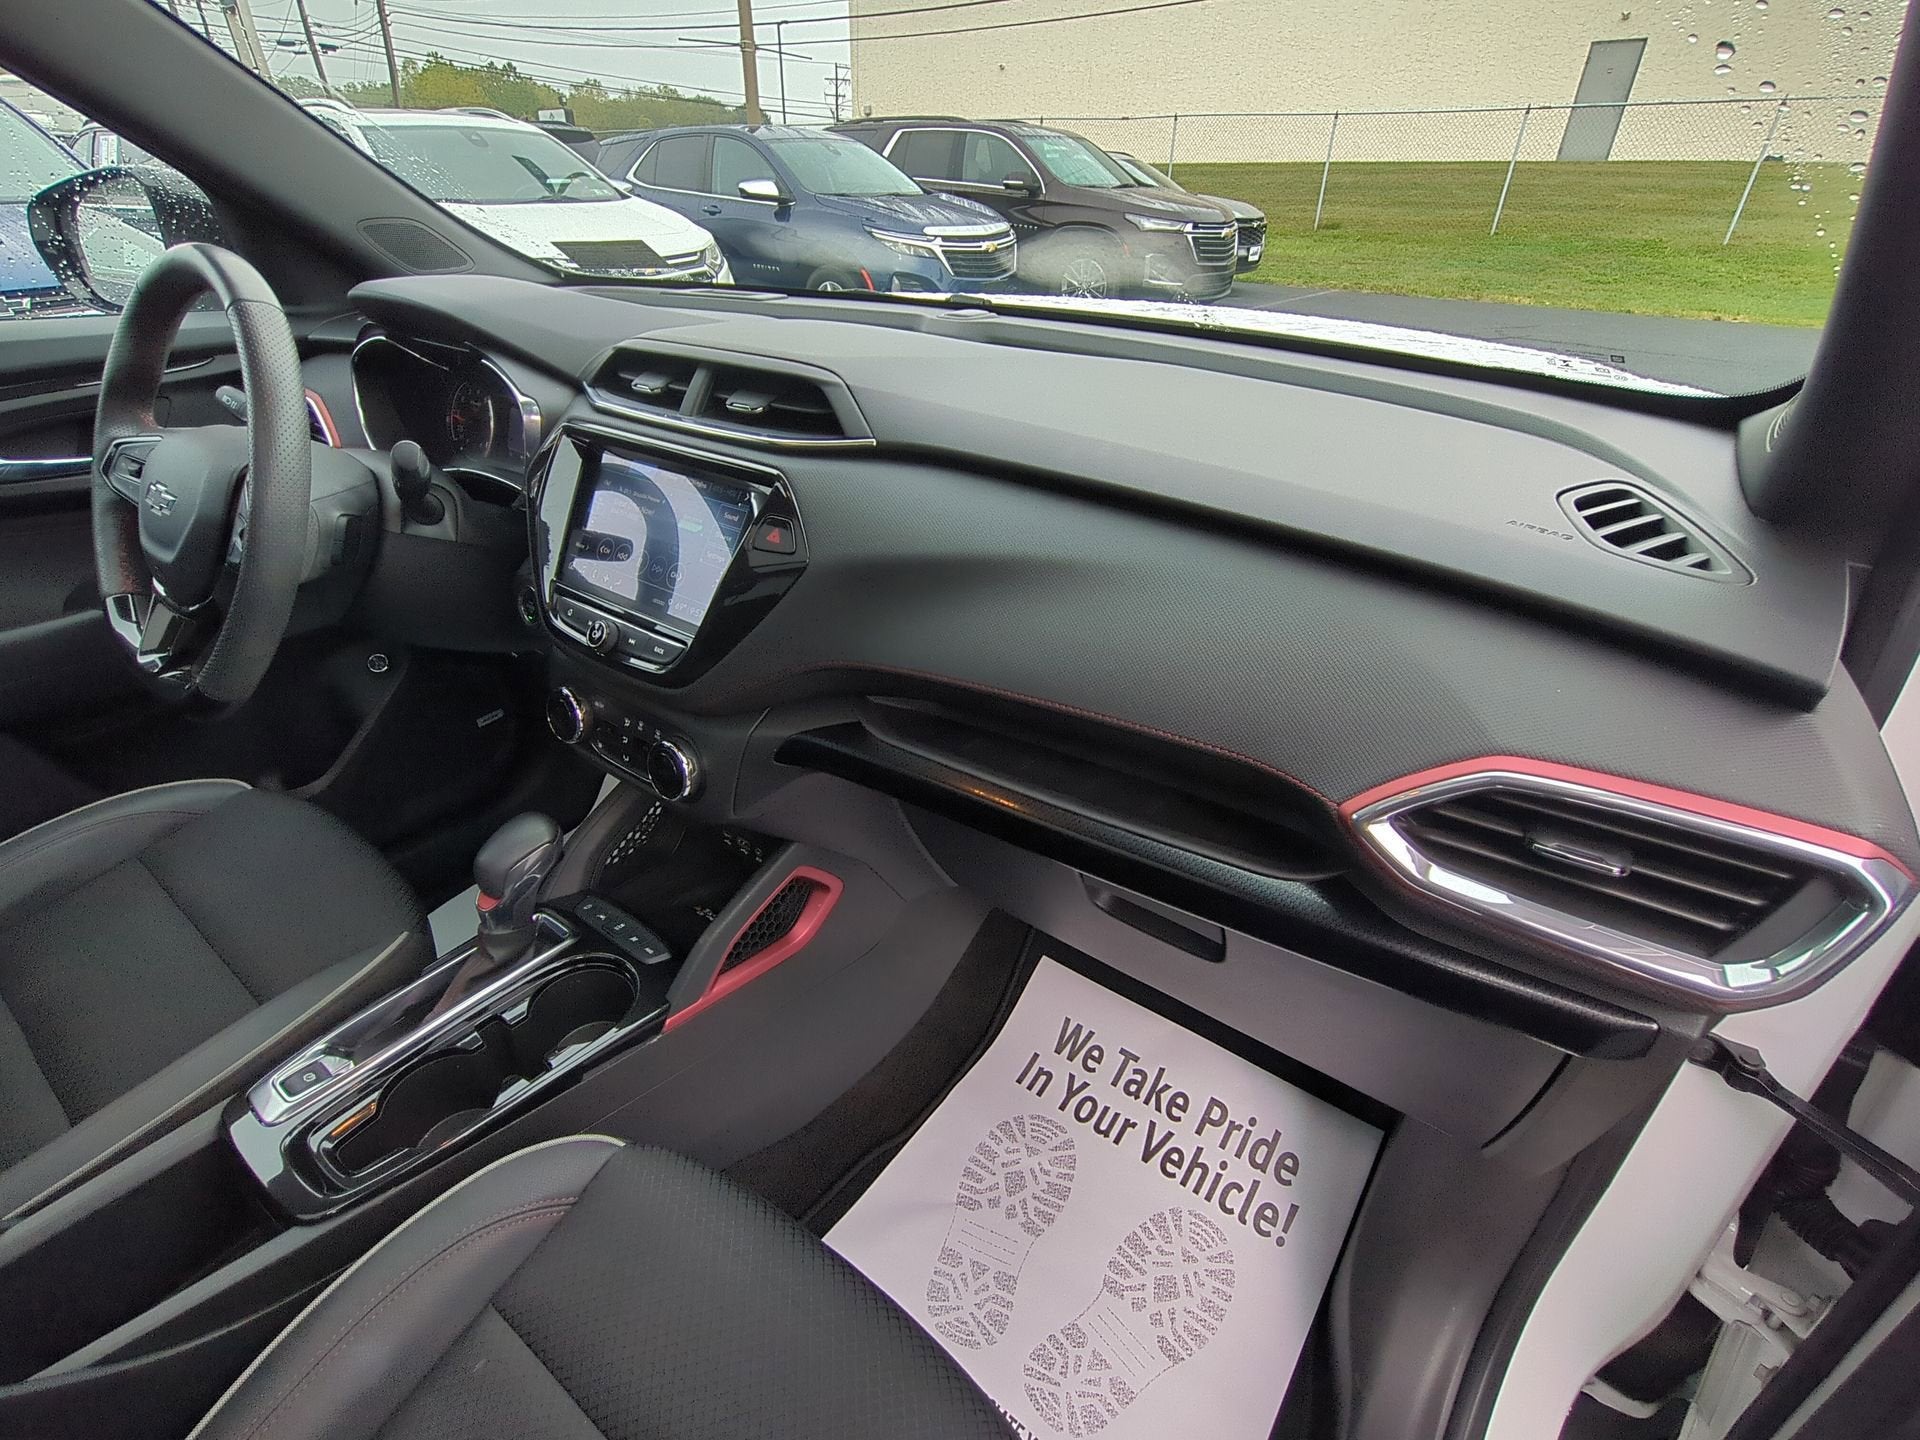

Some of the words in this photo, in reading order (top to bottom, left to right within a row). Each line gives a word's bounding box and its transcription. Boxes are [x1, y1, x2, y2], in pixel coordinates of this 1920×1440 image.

[1505, 519, 1575, 541] AIRBAG
[1015, 1052, 1054, 1098] In
[1058, 1072, 1138, 1146] Your
[1141, 1119, 1300, 1248] Vehicle!
[1053, 1016, 1105, 1074] We
[1110, 1047, 1190, 1123] Take
[1194, 1096, 1300, 1187] Pride
